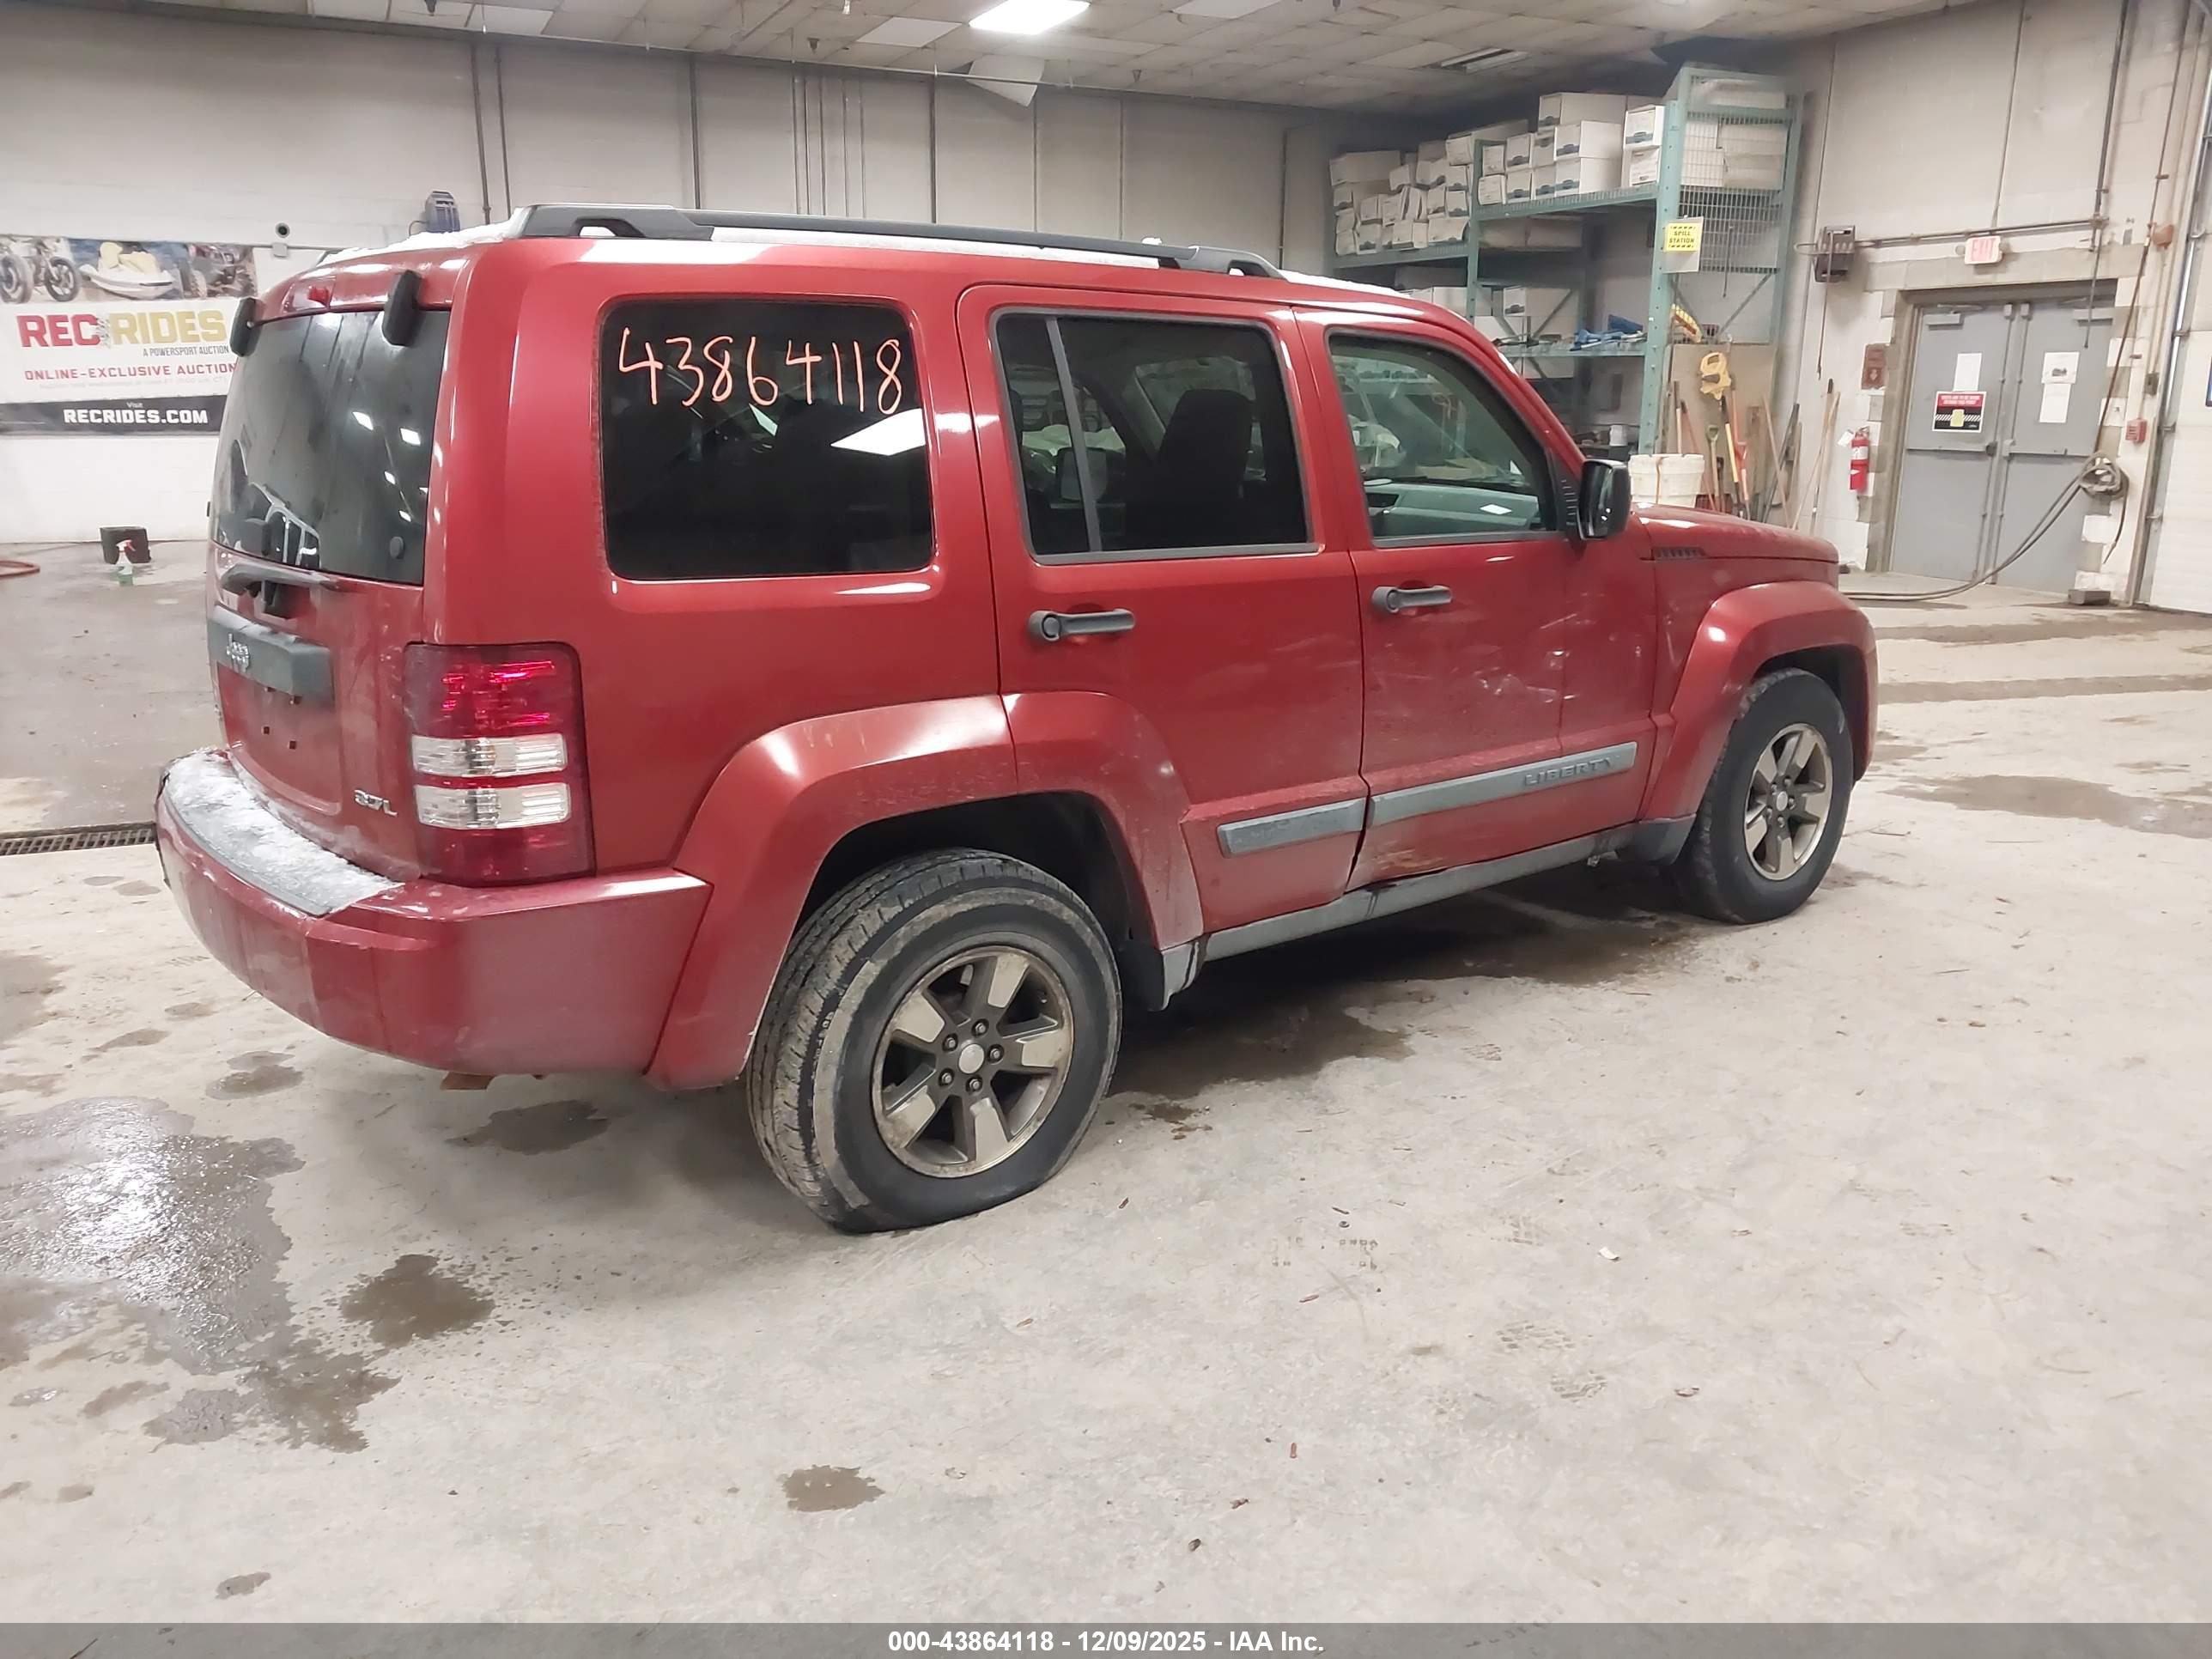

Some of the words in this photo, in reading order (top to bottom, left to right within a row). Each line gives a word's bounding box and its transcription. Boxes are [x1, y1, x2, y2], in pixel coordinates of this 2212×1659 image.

[16, 314, 100, 348] REC
[107, 310, 228, 346] RIDES
[143, 348, 149, 356] A
[149, 346, 198, 356] POWERSPORT
[199, 345, 230, 355] AUCTION
[25, 365, 171, 380] ONLINE-EXCLUSIVE
[618, 326, 902, 415] 43864118
[64, 409, 208, 424] RECRIDES.COM
[1525, 757, 1610, 786] LIBERTY
